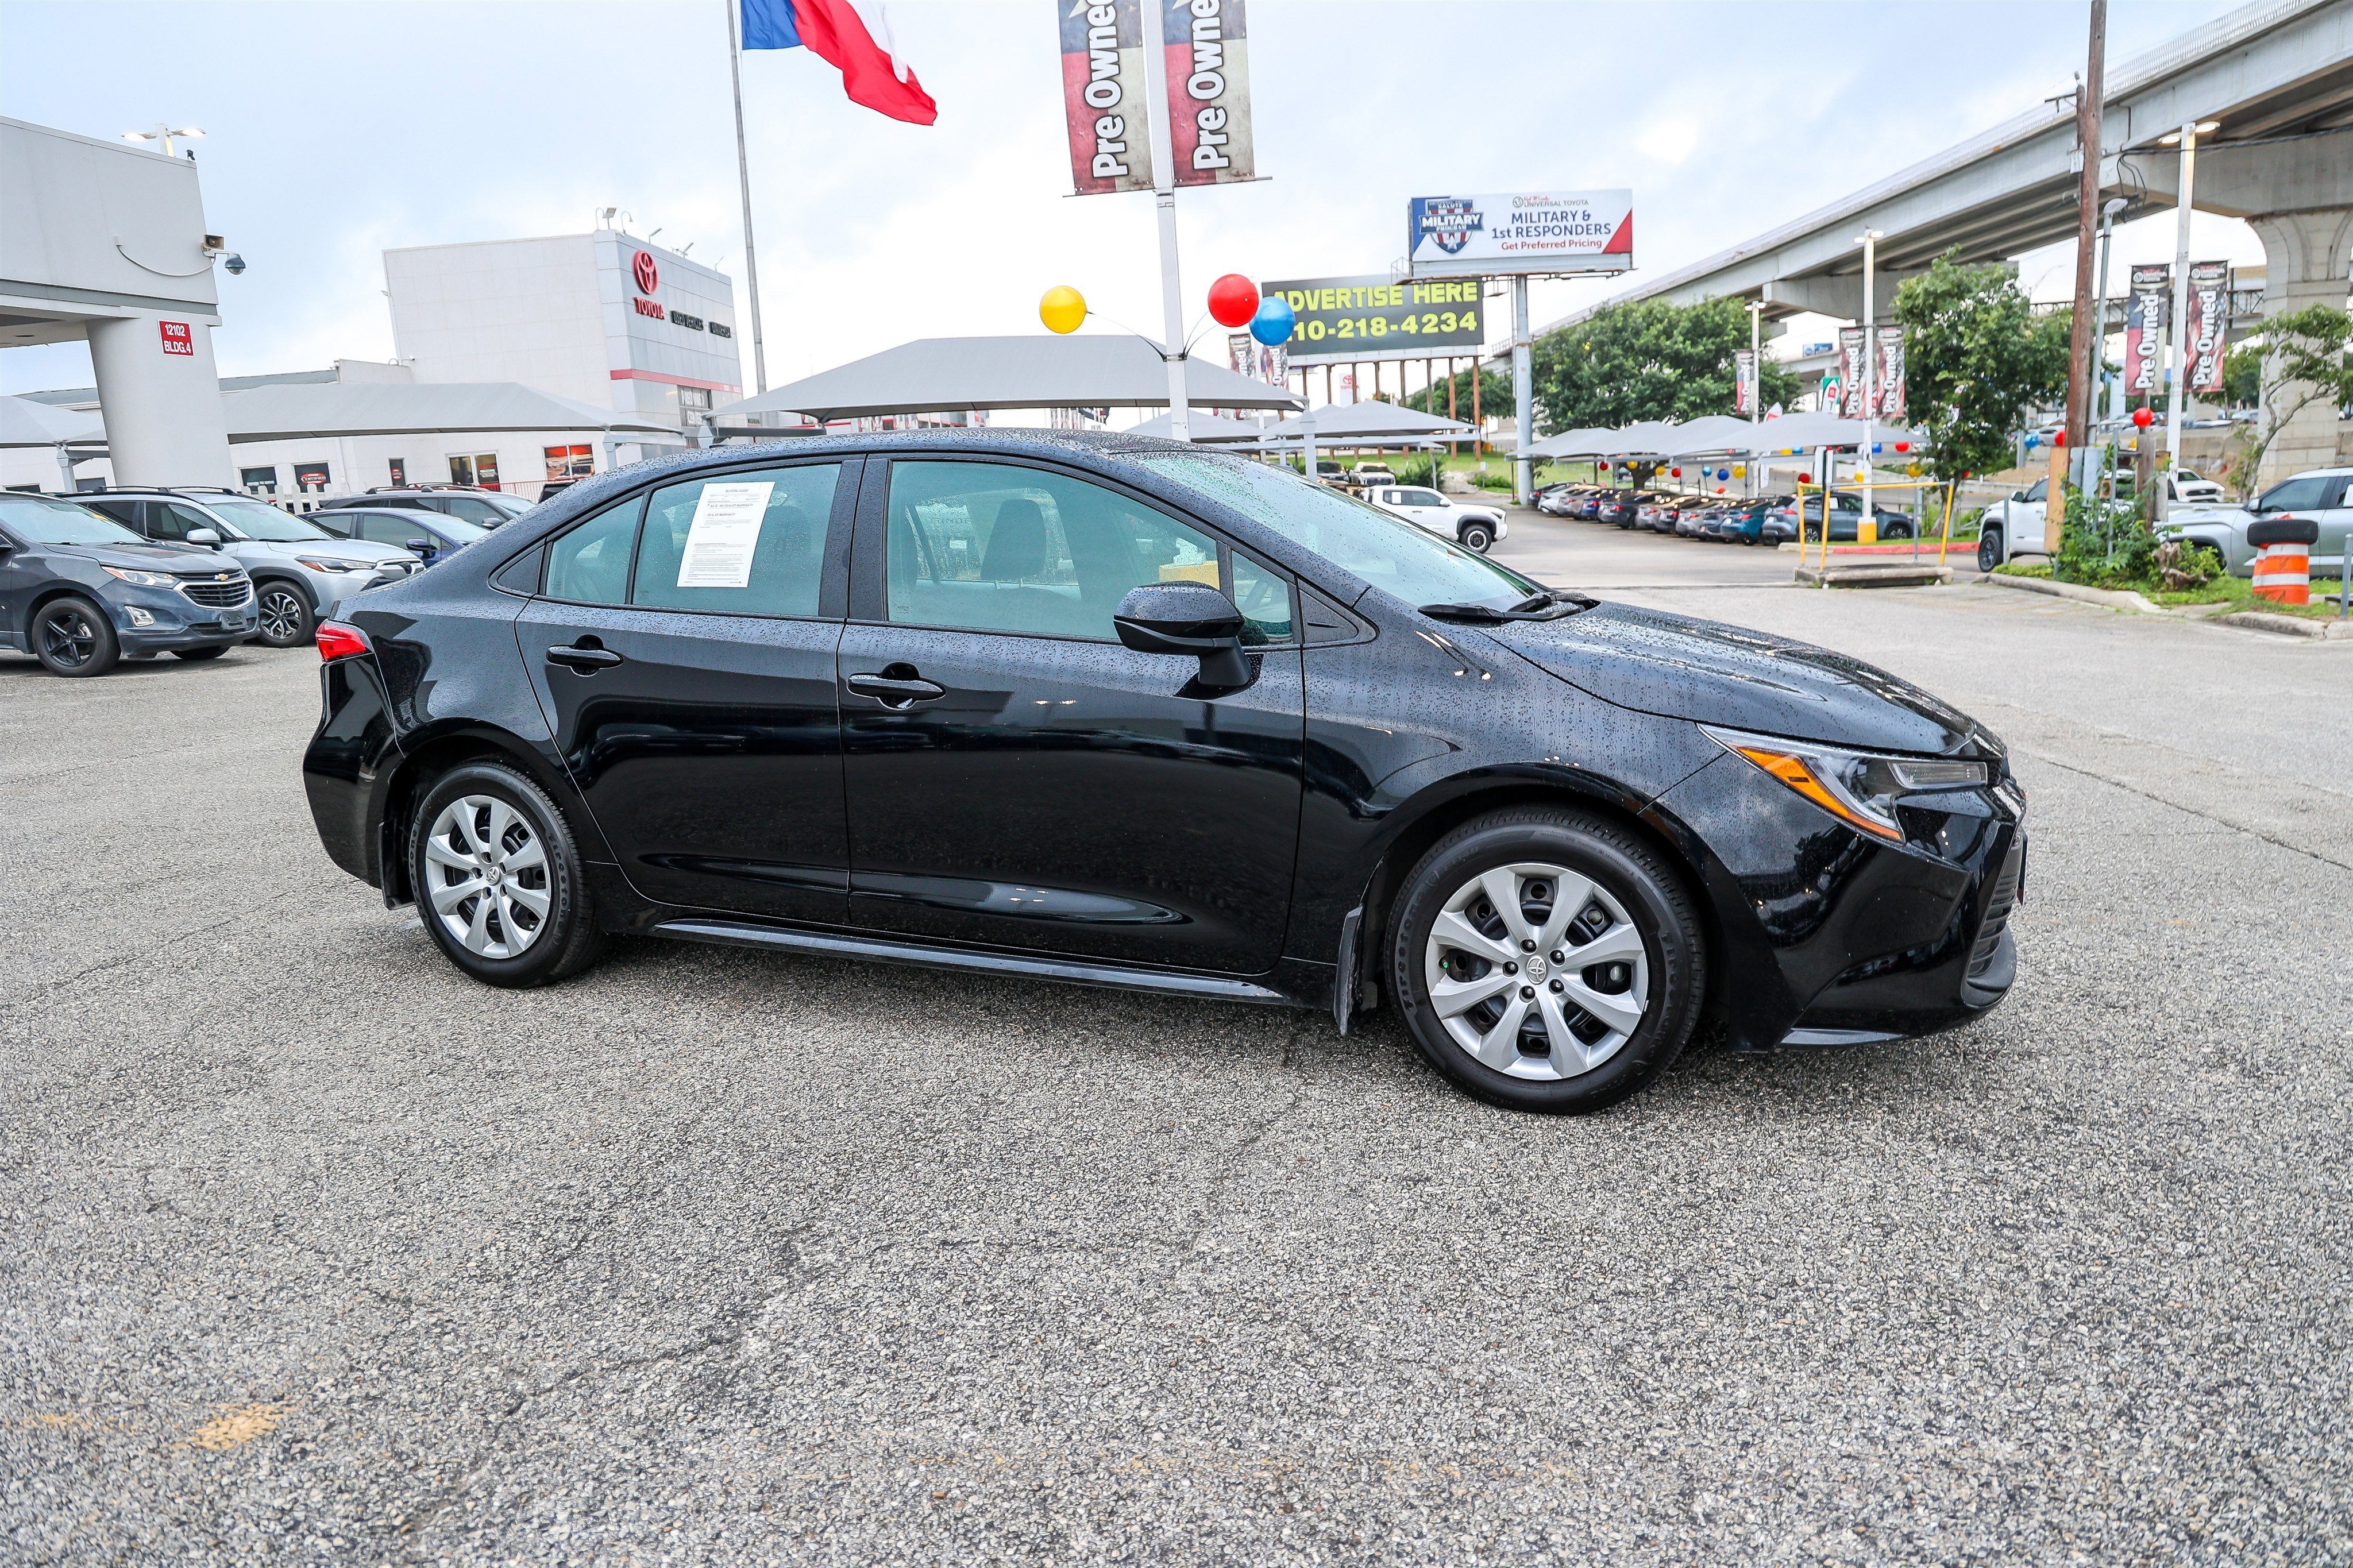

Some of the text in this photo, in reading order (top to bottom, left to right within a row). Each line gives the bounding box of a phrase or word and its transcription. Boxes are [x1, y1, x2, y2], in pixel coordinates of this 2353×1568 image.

[1083, 0, 1129, 179] Pre Owne
[1193, 107, 1230, 170] Pre
[1422, 214, 1480, 227] MILITARY
[1492, 223, 1611, 239] 1st RESPONDERS
[1511, 210, 1591, 224] MILITARY &
[1501, 238, 1602, 250] Get Preferred Pricing
[1413, 281, 1478, 304] HERE
[634, 297, 665, 320] TOYOTA
[2196, 290, 2217, 353] Owned
[164, 323, 186, 337] 12102
[1287, 309, 1478, 342] 10-218-4234
[2136, 293, 2159, 357] Owned
[1846, 347, 1860, 391] Owned
[1883, 345, 1897, 391] Owned
[2135, 358, 2156, 389] Pre
[2192, 354, 2212, 385] Pre
[1845, 391, 1859, 414] Pre
[1882, 391, 1896, 413] Pre
[547, 834, 568, 931] Firestone
